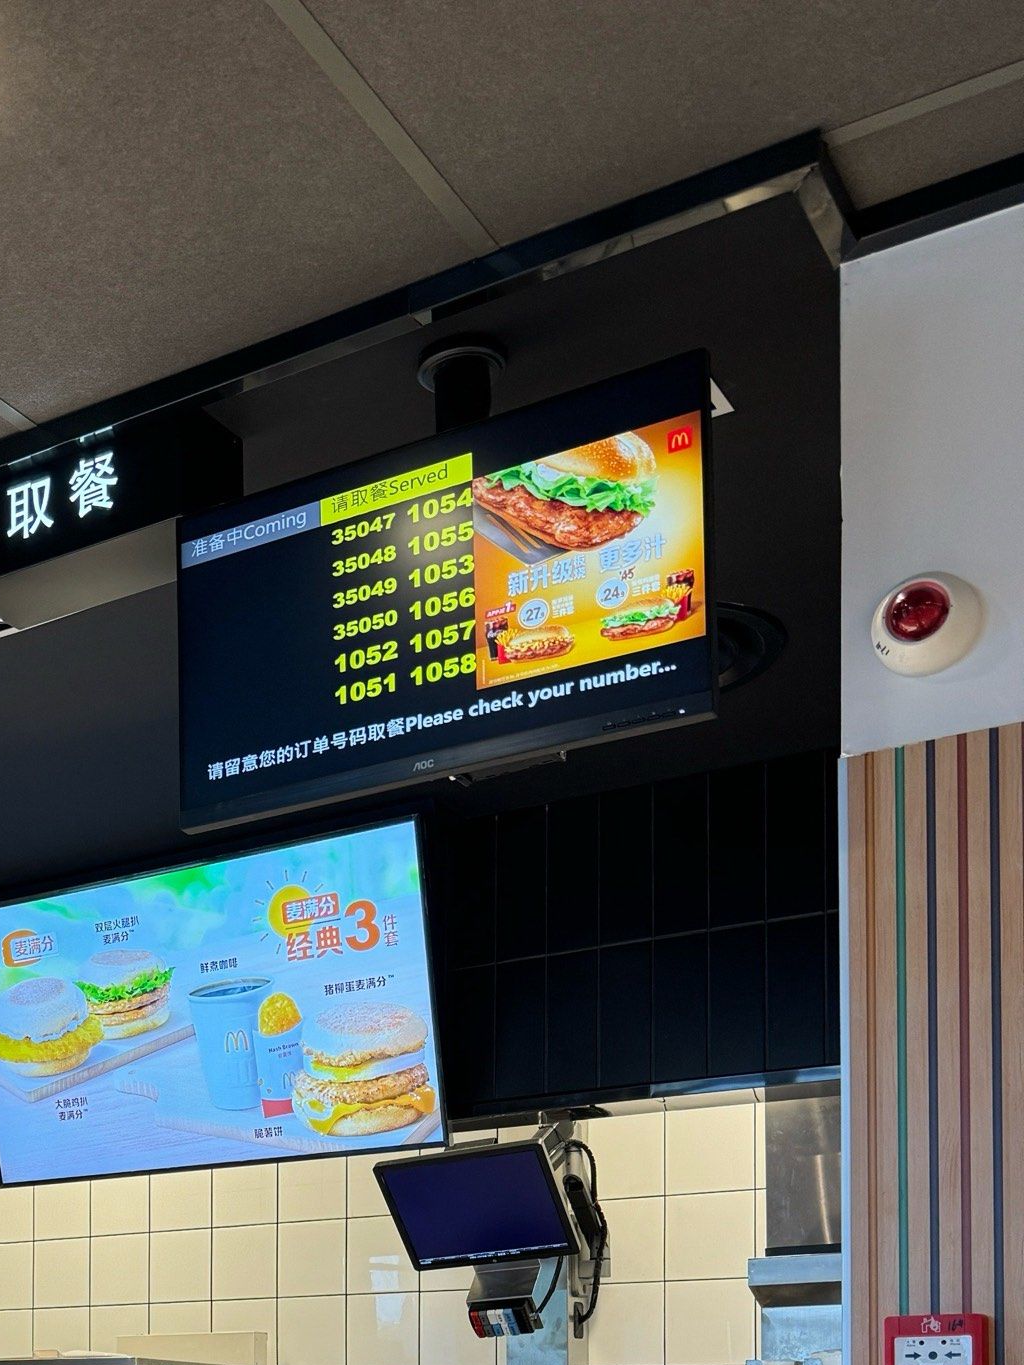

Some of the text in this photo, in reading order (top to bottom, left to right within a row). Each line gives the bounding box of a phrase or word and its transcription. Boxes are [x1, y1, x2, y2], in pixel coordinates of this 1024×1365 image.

[7, 452, 118, 539] 取餐
[331, 488, 474, 545] 35047 1054
[332, 521, 475, 577] 35048 1055
[332, 554, 475, 609] 35049 1053
[333, 587, 476, 641] 35050 1056
[334, 619, 476, 673] 1052 1057
[334, 673, 397, 705] 1051
[410, 652, 477, 686] 1058
[469, 691, 523, 718] check
[528, 681, 574, 708] your
[579, 660, 677, 692] number...
[413, 759, 435, 771] AOC
[286, 898, 336, 922] 麦满分
[14, 935, 55, 957] 麦满分
